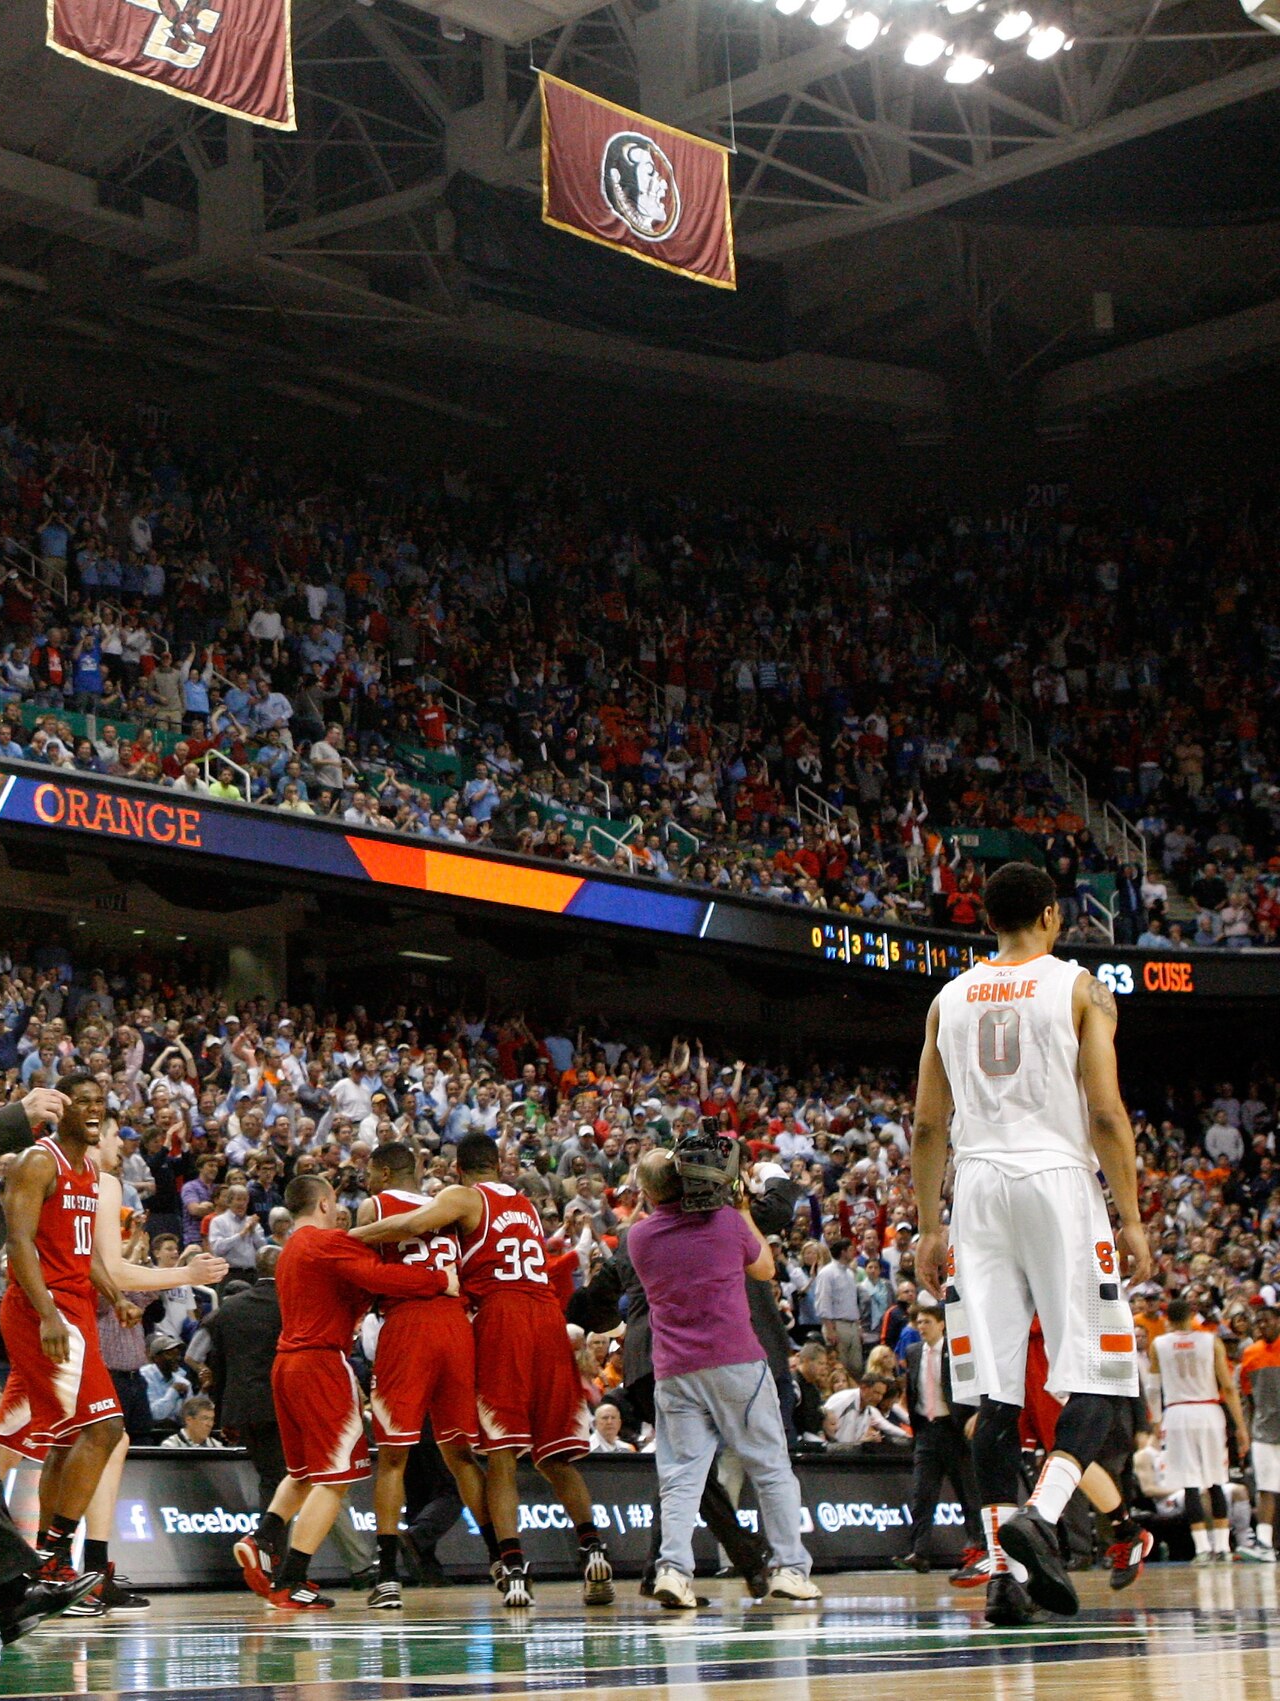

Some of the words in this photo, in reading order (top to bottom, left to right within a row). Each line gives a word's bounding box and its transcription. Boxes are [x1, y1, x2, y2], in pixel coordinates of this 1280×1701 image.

[33, 783, 202, 847] ORANGE
[811, 926, 822, 948] 0
[851, 933, 862, 955] 3
[890, 941, 900, 962] 5
[931, 947, 947, 968] 11
[966, 979, 1038, 1003] GBINIJE
[1096, 963, 1135, 995] 63
[1143, 961, 1195, 993] CUSE
[978, 1006, 1021, 1077] 0
[77, 1194, 97, 1212] STAT
[73, 1215, 92, 1255] 10
[398, 1236, 457, 1275] 22
[494, 1237, 549, 1285] 32
[88, 1398, 117, 1414] PACK
[626, 1503, 654, 1529] #P
[933, 1503, 966, 1526] CC
